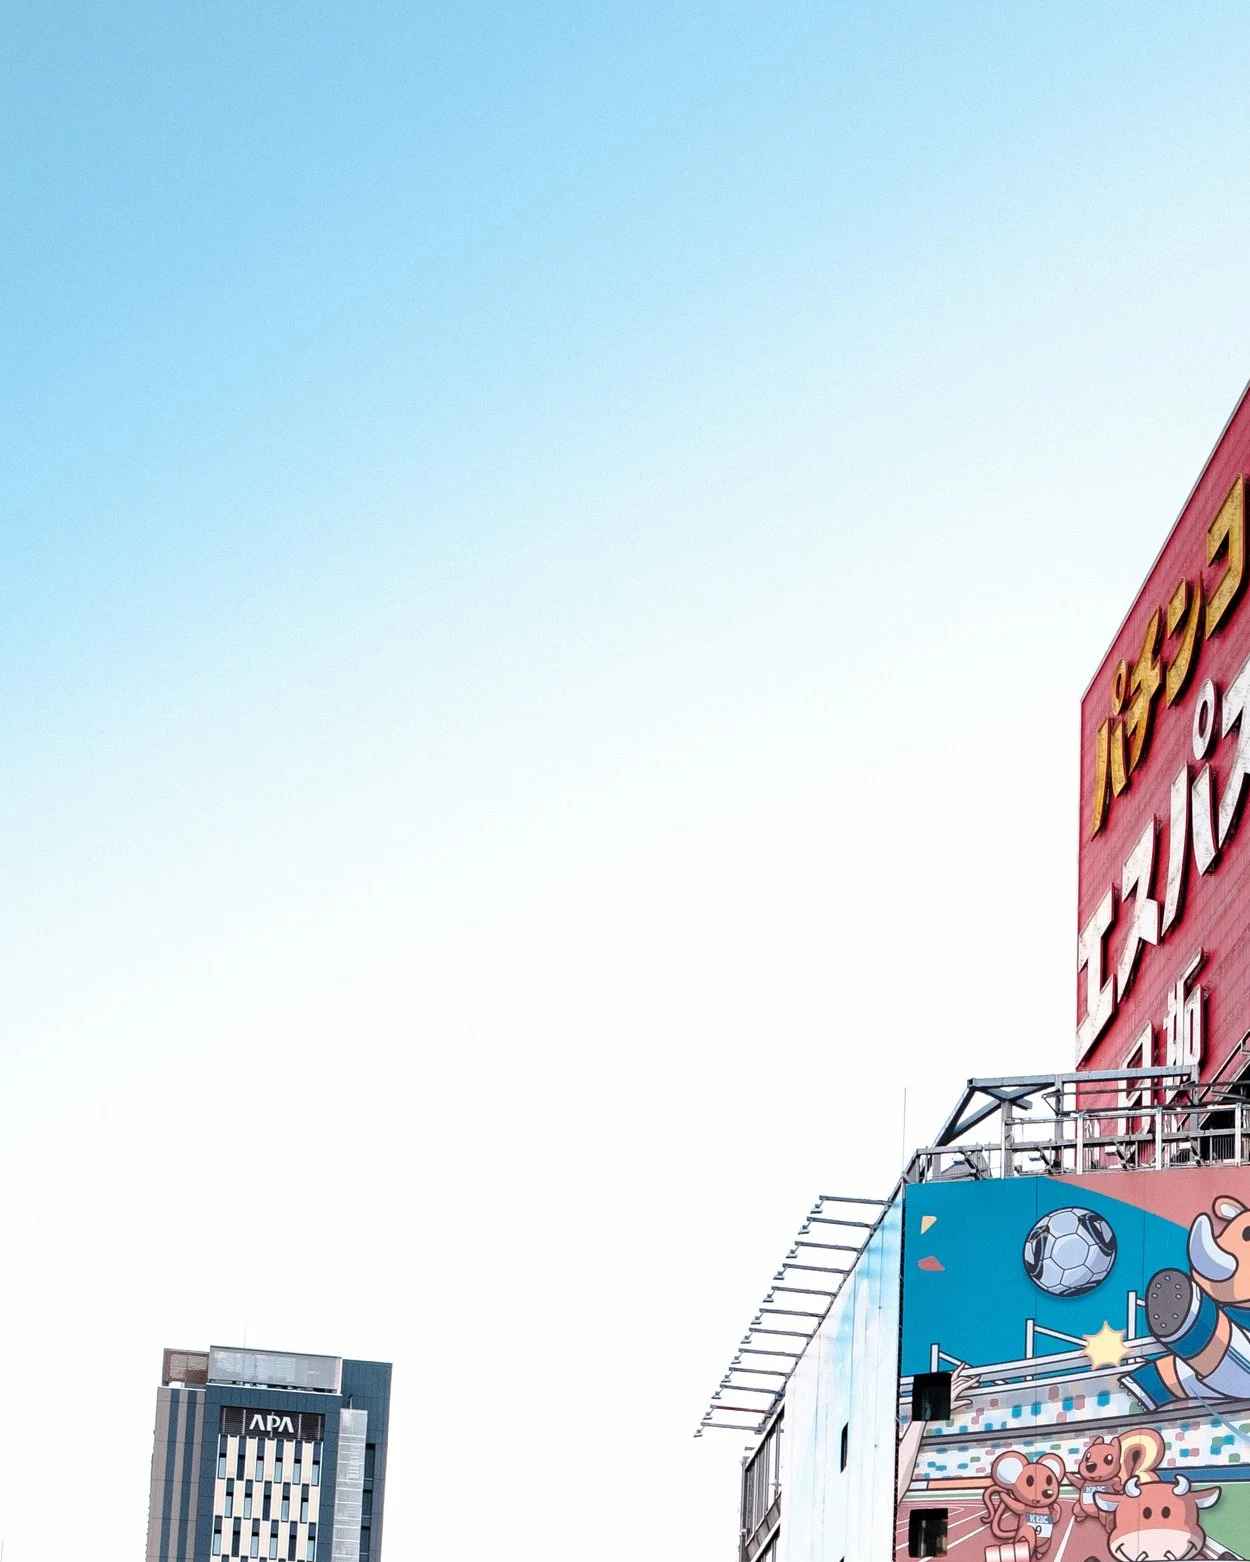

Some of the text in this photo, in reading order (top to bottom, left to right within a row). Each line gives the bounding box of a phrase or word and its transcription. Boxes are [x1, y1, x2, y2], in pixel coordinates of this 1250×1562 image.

[1091, 474, 1246, 841] パチンコ
[249, 1413, 295, 1434] APA
